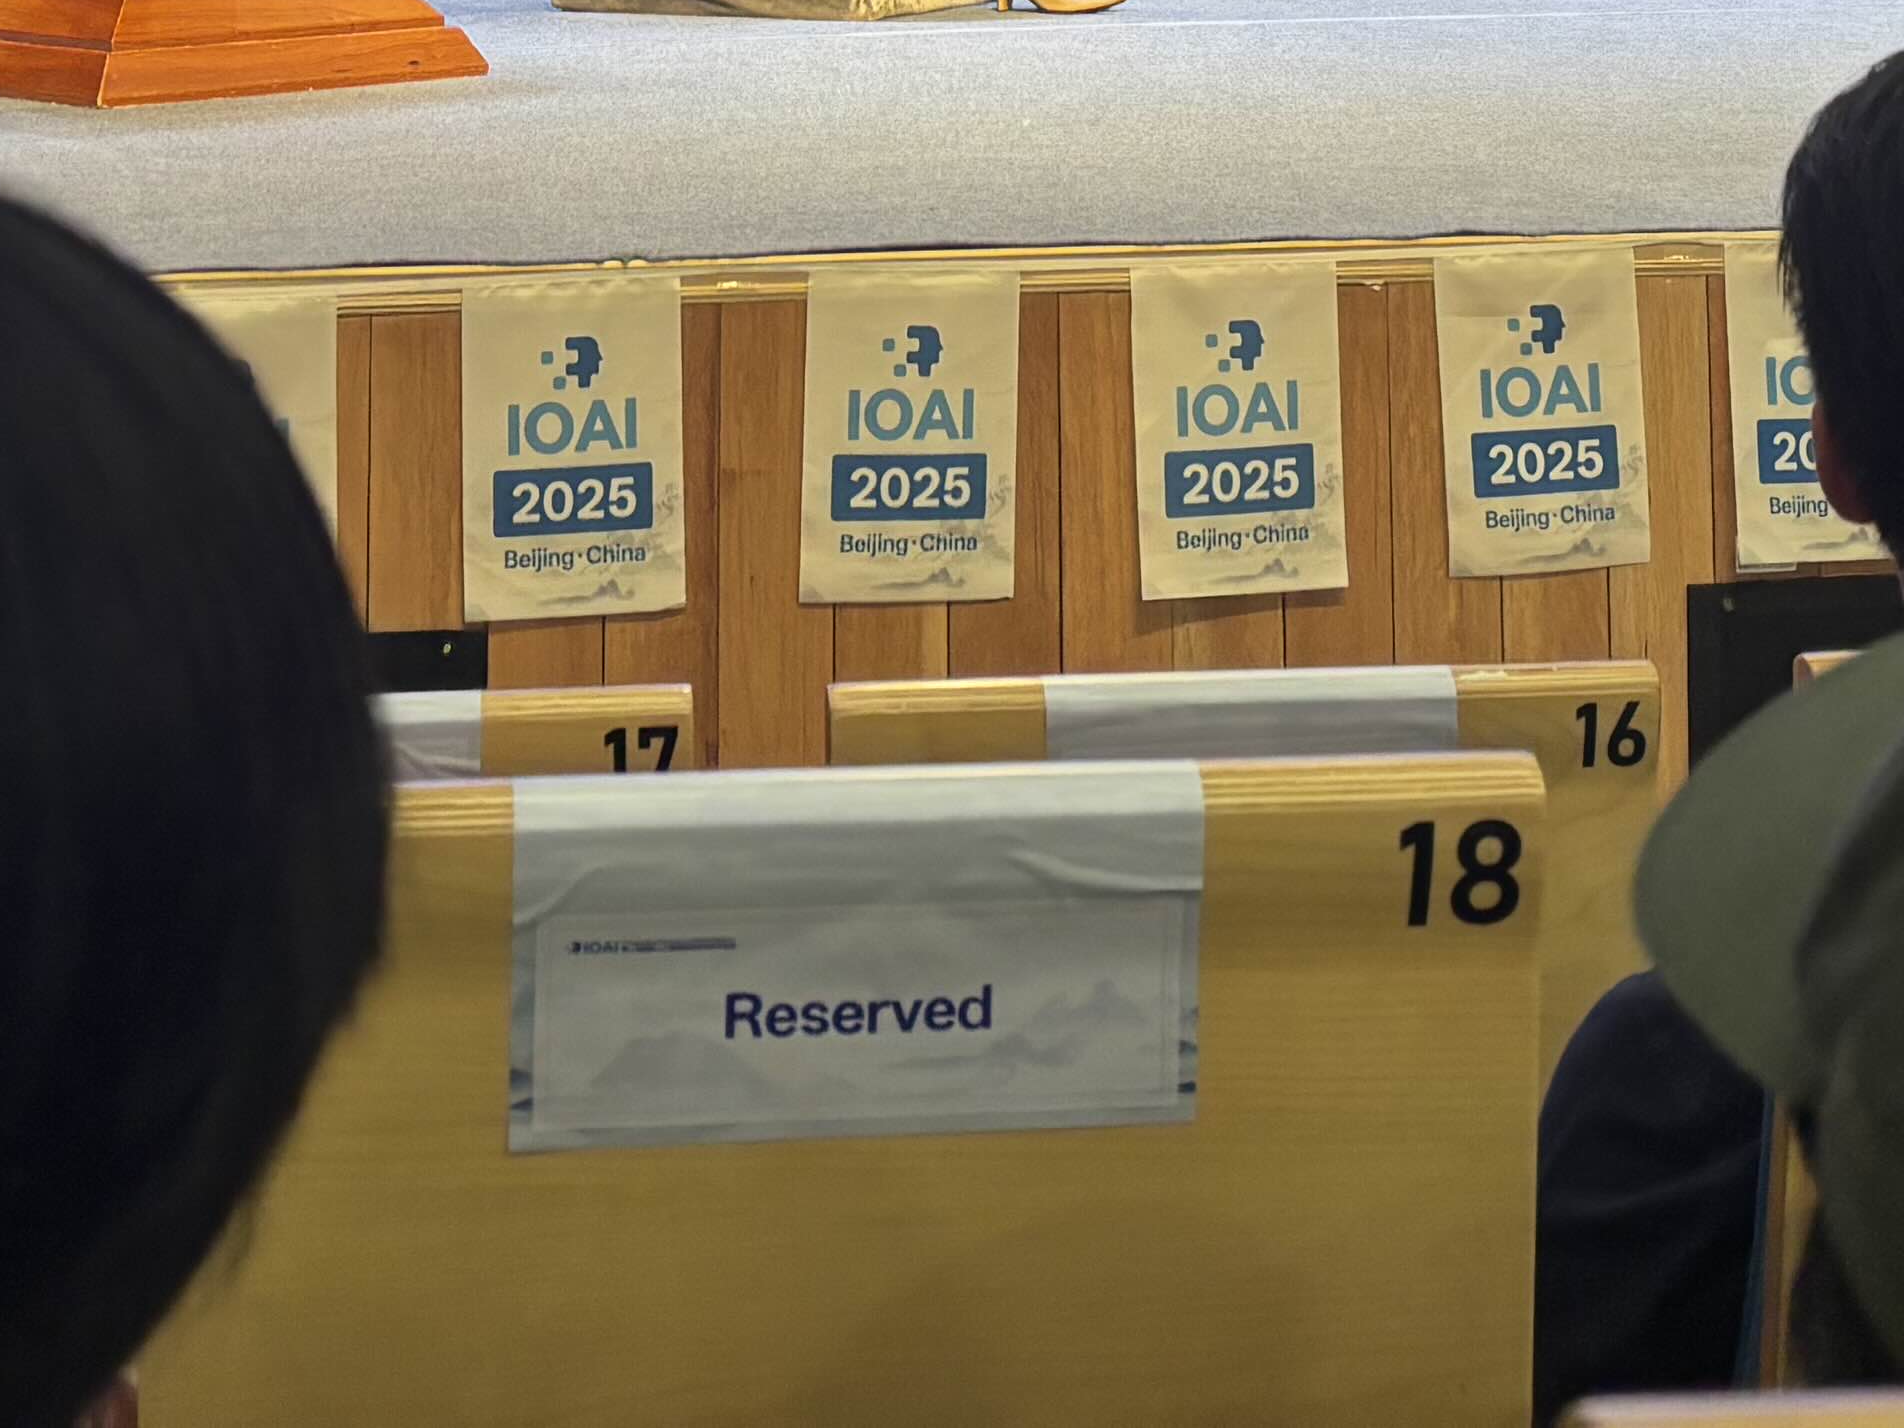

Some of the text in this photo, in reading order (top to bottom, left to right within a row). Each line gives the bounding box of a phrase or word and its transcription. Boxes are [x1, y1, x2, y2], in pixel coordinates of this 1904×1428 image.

[847, 387, 976, 442] IOAI
[1175, 379, 1299, 438] IOAI
[1479, 362, 1601, 419] IOAI
[507, 396, 639, 456] IOAI
[849, 465, 973, 509] 2025
[1181, 457, 1300, 505] 2025
[1486, 438, 1605, 487] 2025
[511, 475, 638, 524] 2025
[603, 726, 679, 772] 17
[1574, 701, 1647, 769] 16
[1394, 819, 1523, 930] 18
[723, 983, 994, 1043] Reserved
